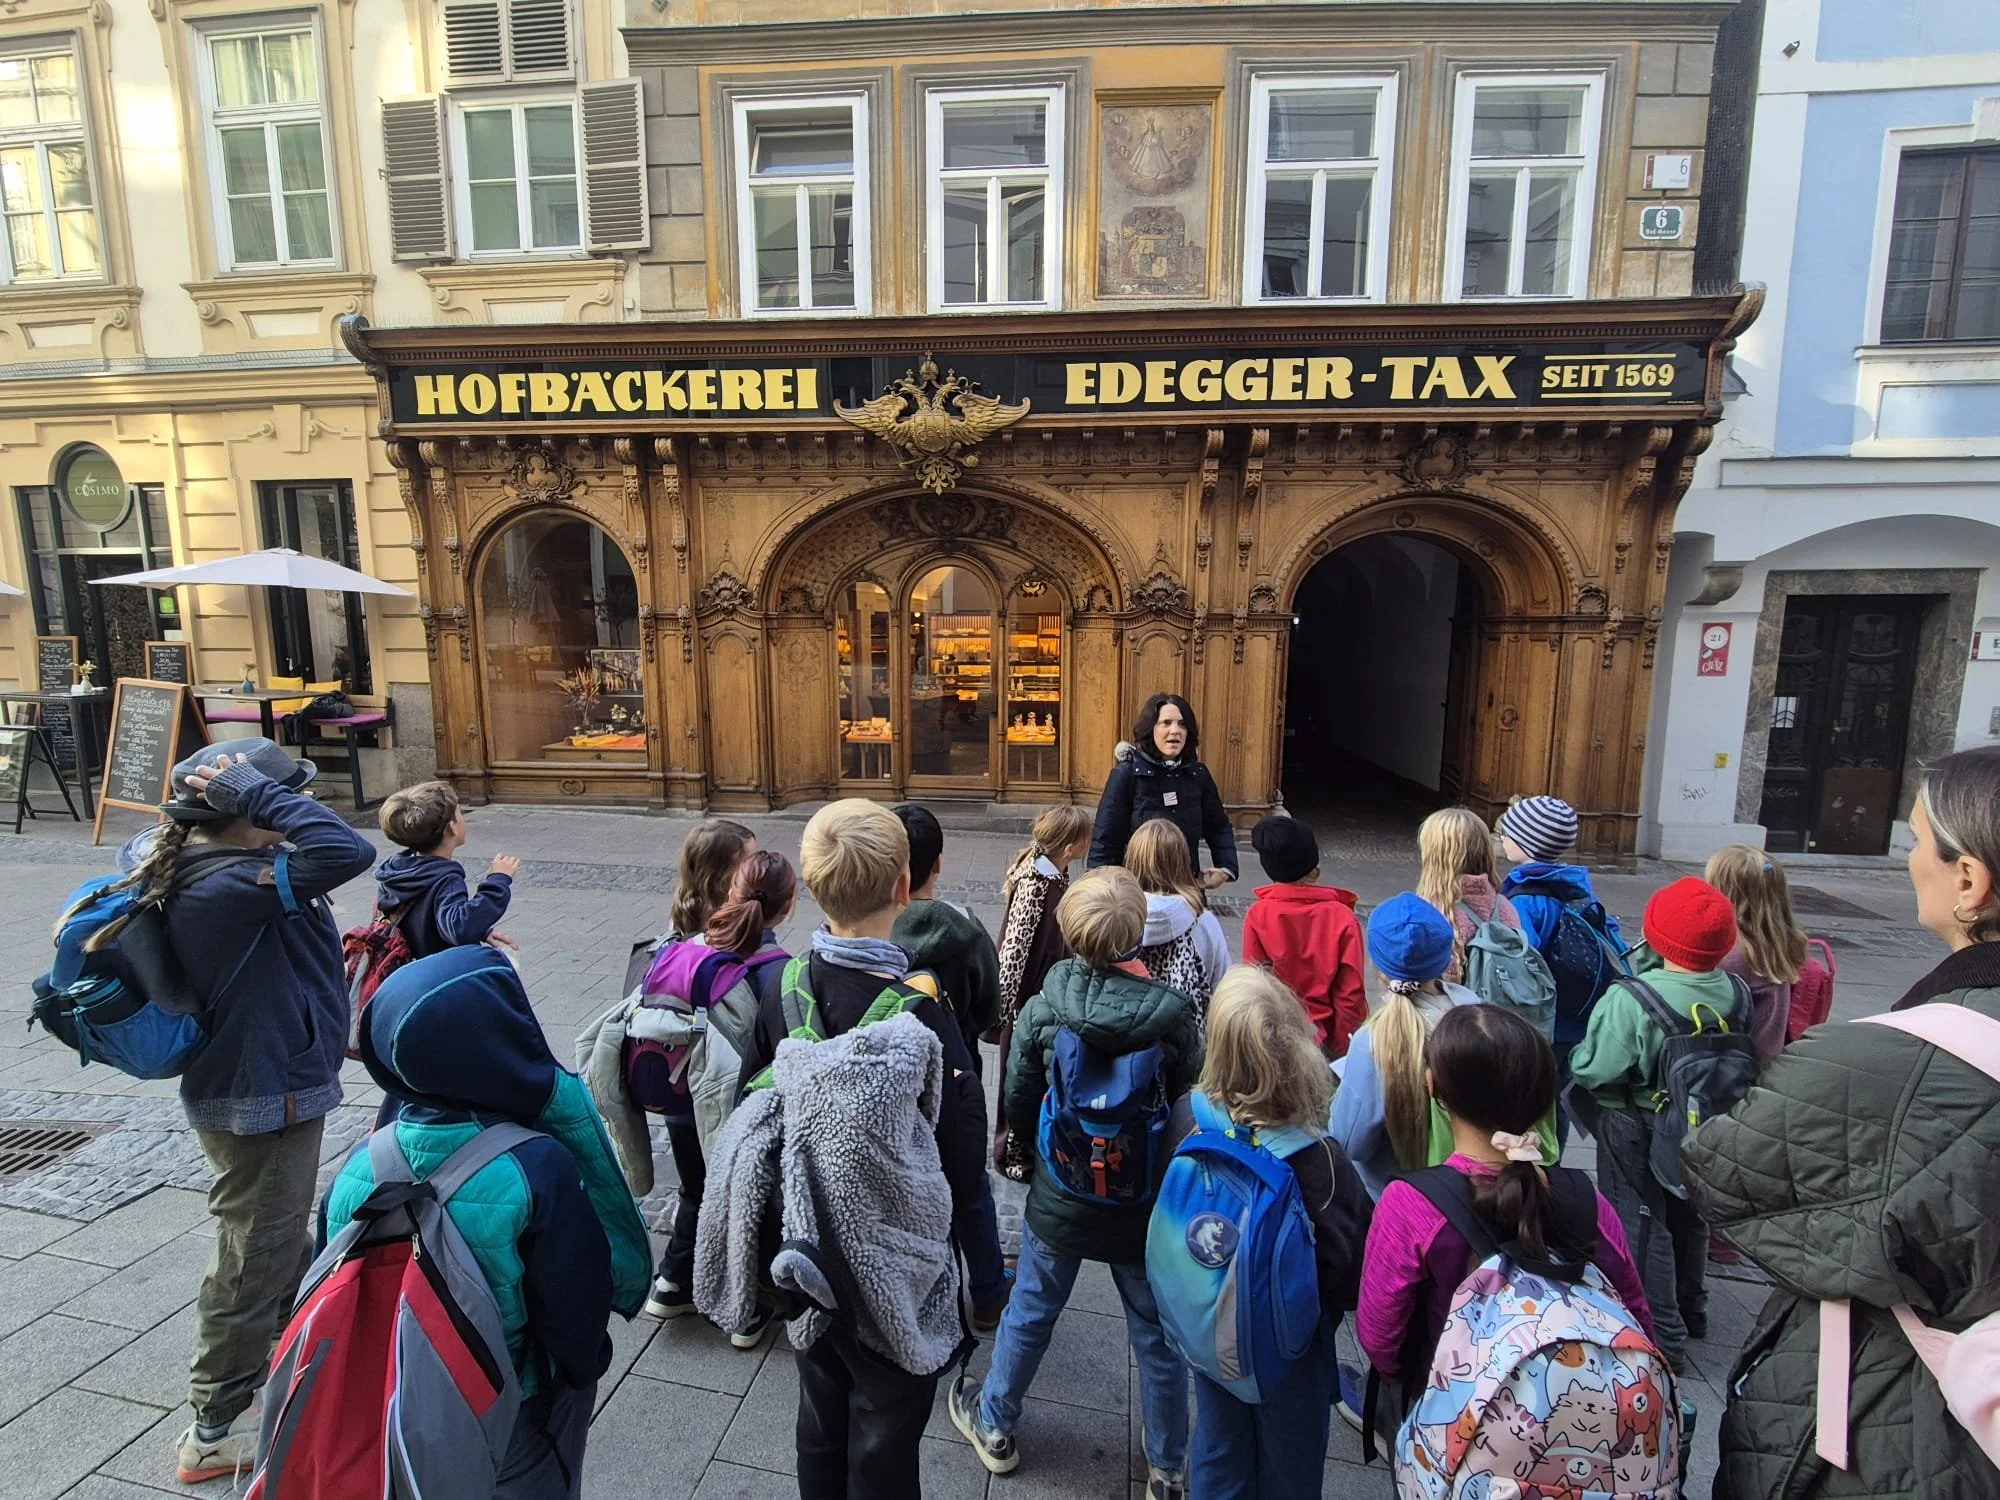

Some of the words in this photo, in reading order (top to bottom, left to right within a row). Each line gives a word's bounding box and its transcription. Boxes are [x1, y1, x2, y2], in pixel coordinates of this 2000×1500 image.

[1680, 158, 1687, 175] 6
[1656, 209, 1668, 228] 6
[1065, 355, 1516, 405] EDEGGER-TAX
[1541, 365, 1610, 388] SEIT
[1615, 363, 1675, 387] 1569
[414, 368, 819, 415] HOFBÄCKEREI
[74, 484, 120, 497] COSIMO
[1710, 633, 1722, 642] 21
